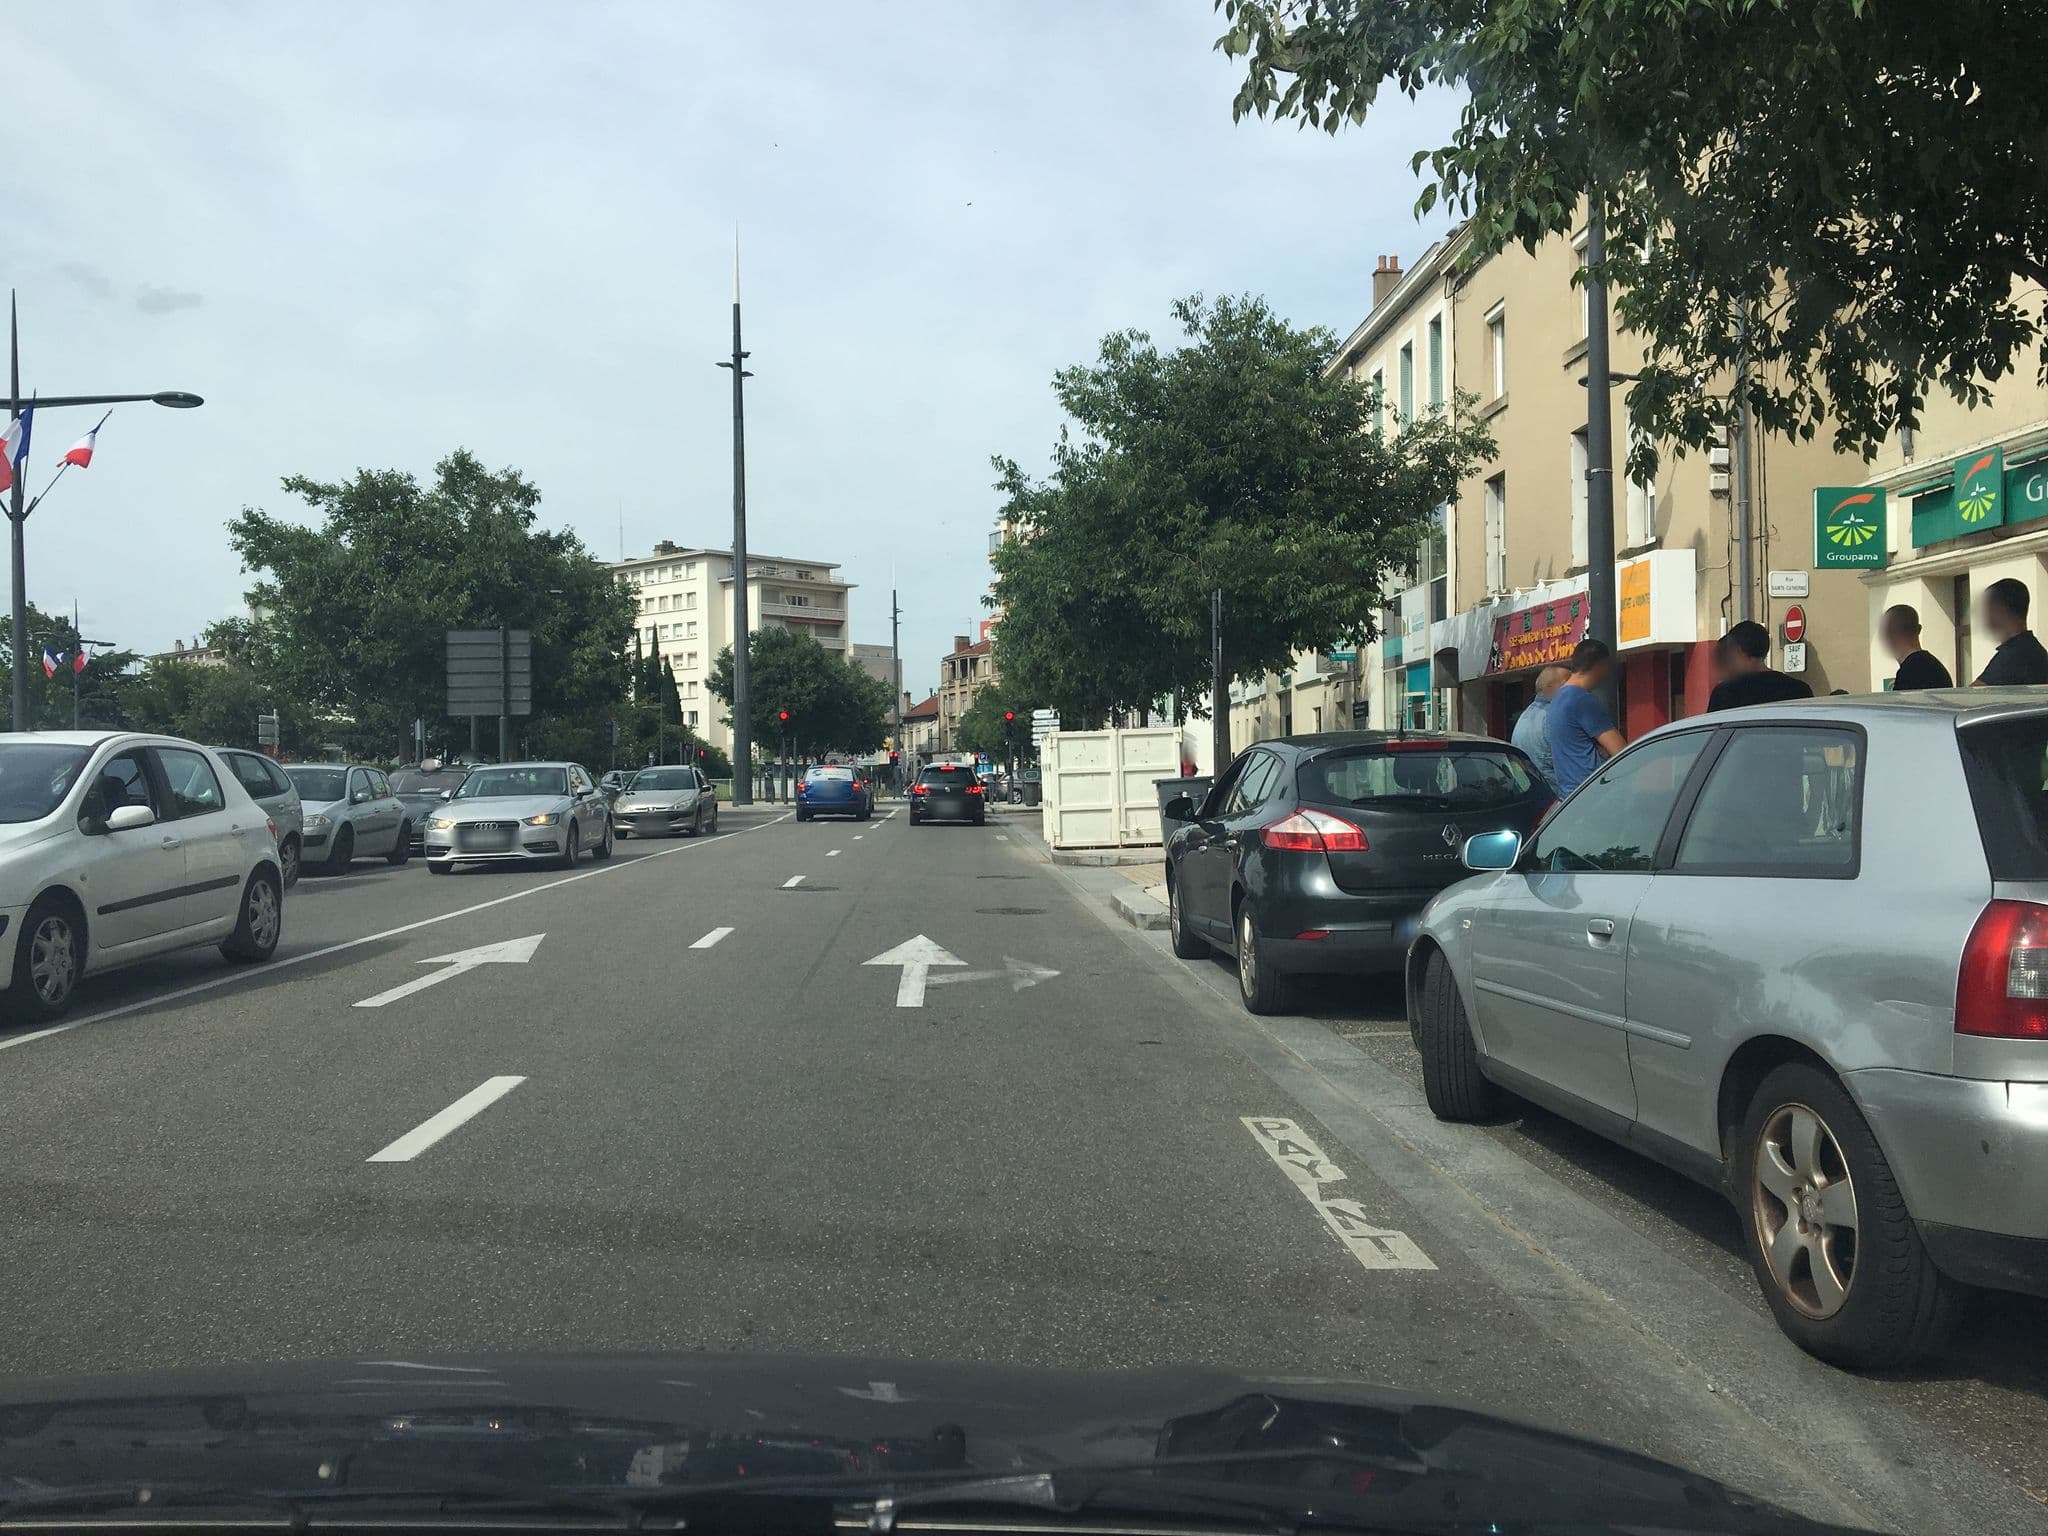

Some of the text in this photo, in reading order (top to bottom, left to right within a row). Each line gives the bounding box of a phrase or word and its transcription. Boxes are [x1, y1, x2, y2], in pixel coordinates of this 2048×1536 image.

[1826, 552, 1879, 562] Groupama
[1788, 645, 1801, 653] SAUF
[1502, 650, 1533, 670] Panda
[1249, 1119, 1405, 1263] PAYNT
